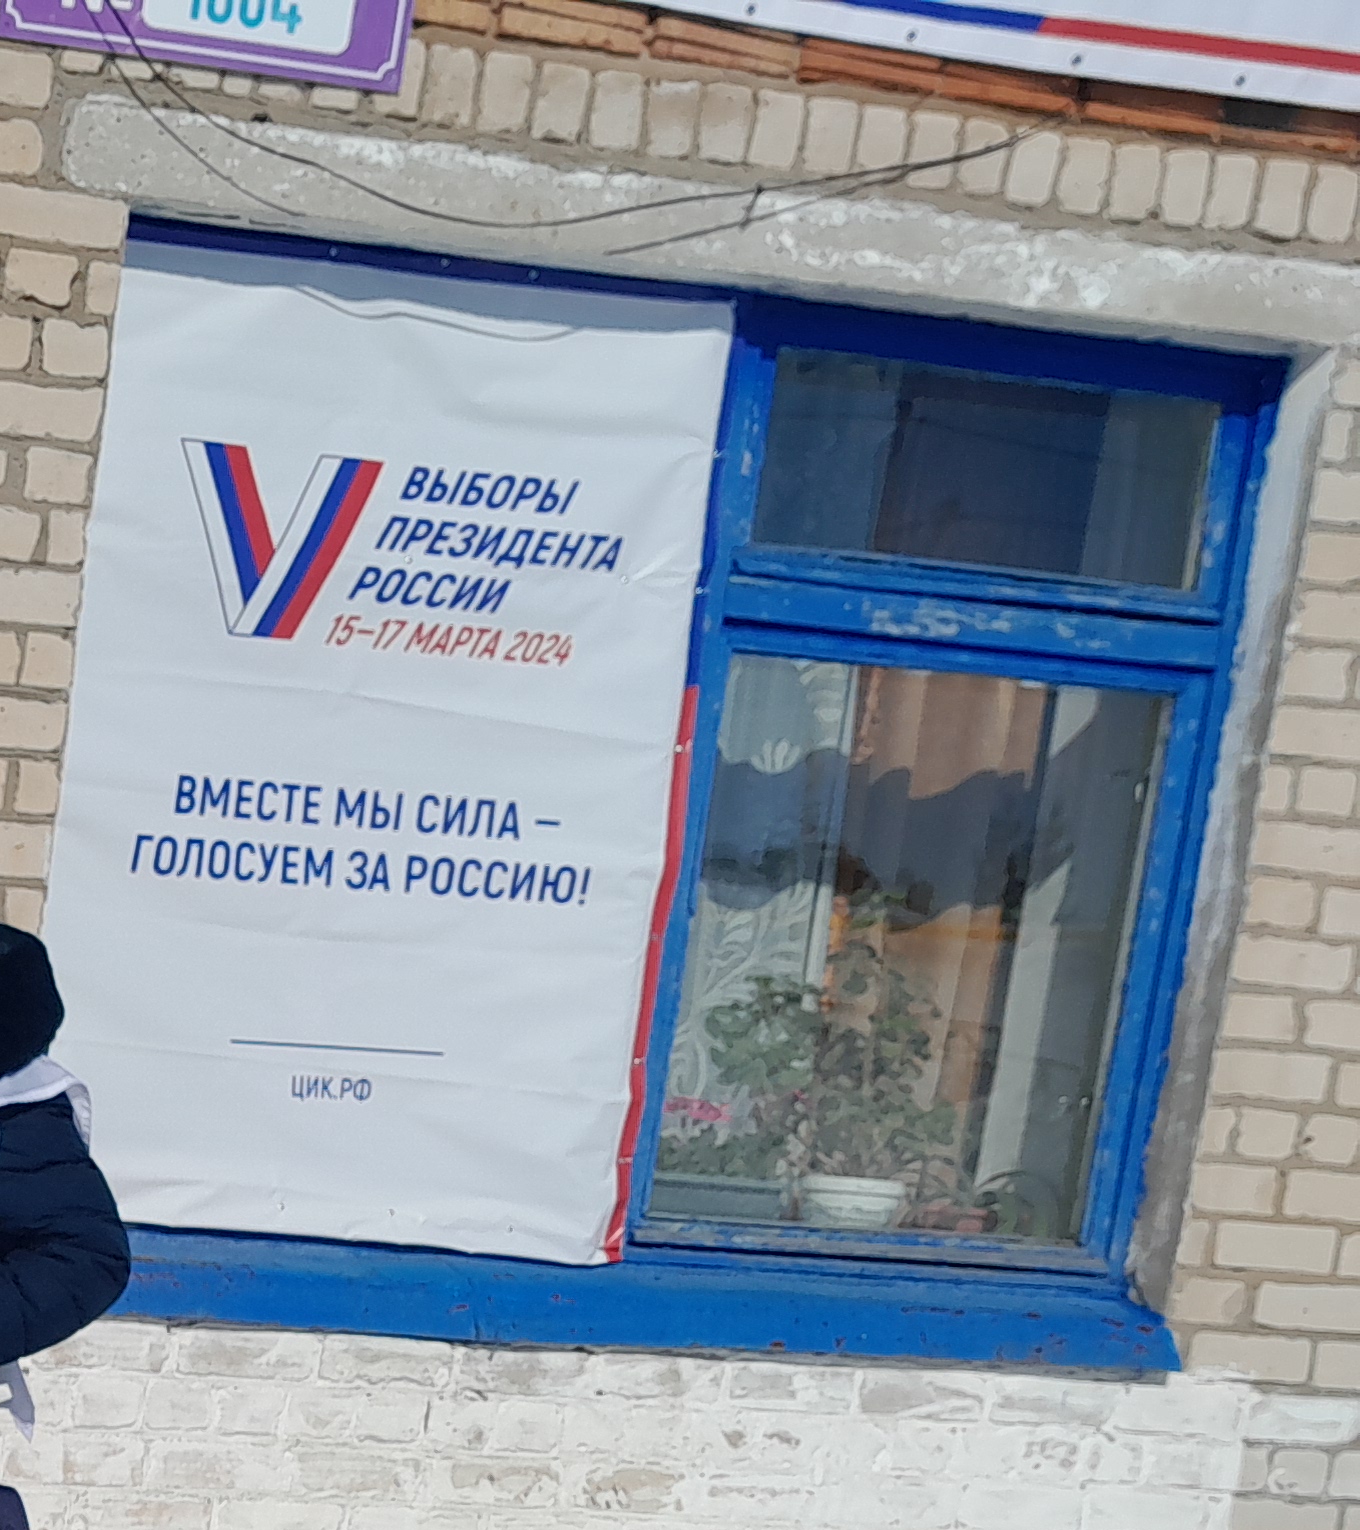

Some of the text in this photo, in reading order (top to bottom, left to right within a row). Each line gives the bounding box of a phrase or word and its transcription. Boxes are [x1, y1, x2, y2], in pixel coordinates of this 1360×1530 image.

[400, 465, 580, 517] ВЫБОРЫ
[374, 515, 626, 574] ПРЕЗИДЕНТА
[348, 565, 513, 615] РОССИИ
[404, 621, 501, 662] МАРТА
[504, 630, 576, 666] 2024
[174, 773, 323, 826] ВМЕСТЕ
[334, 787, 406, 832] МЫ
[415, 796, 521, 842] СИЛА
[130, 833, 593, 907] ГОЛОСУЕМ ЗА РОССИЮ!
[290, 1073, 373, 1104] ЦИК.РФ
